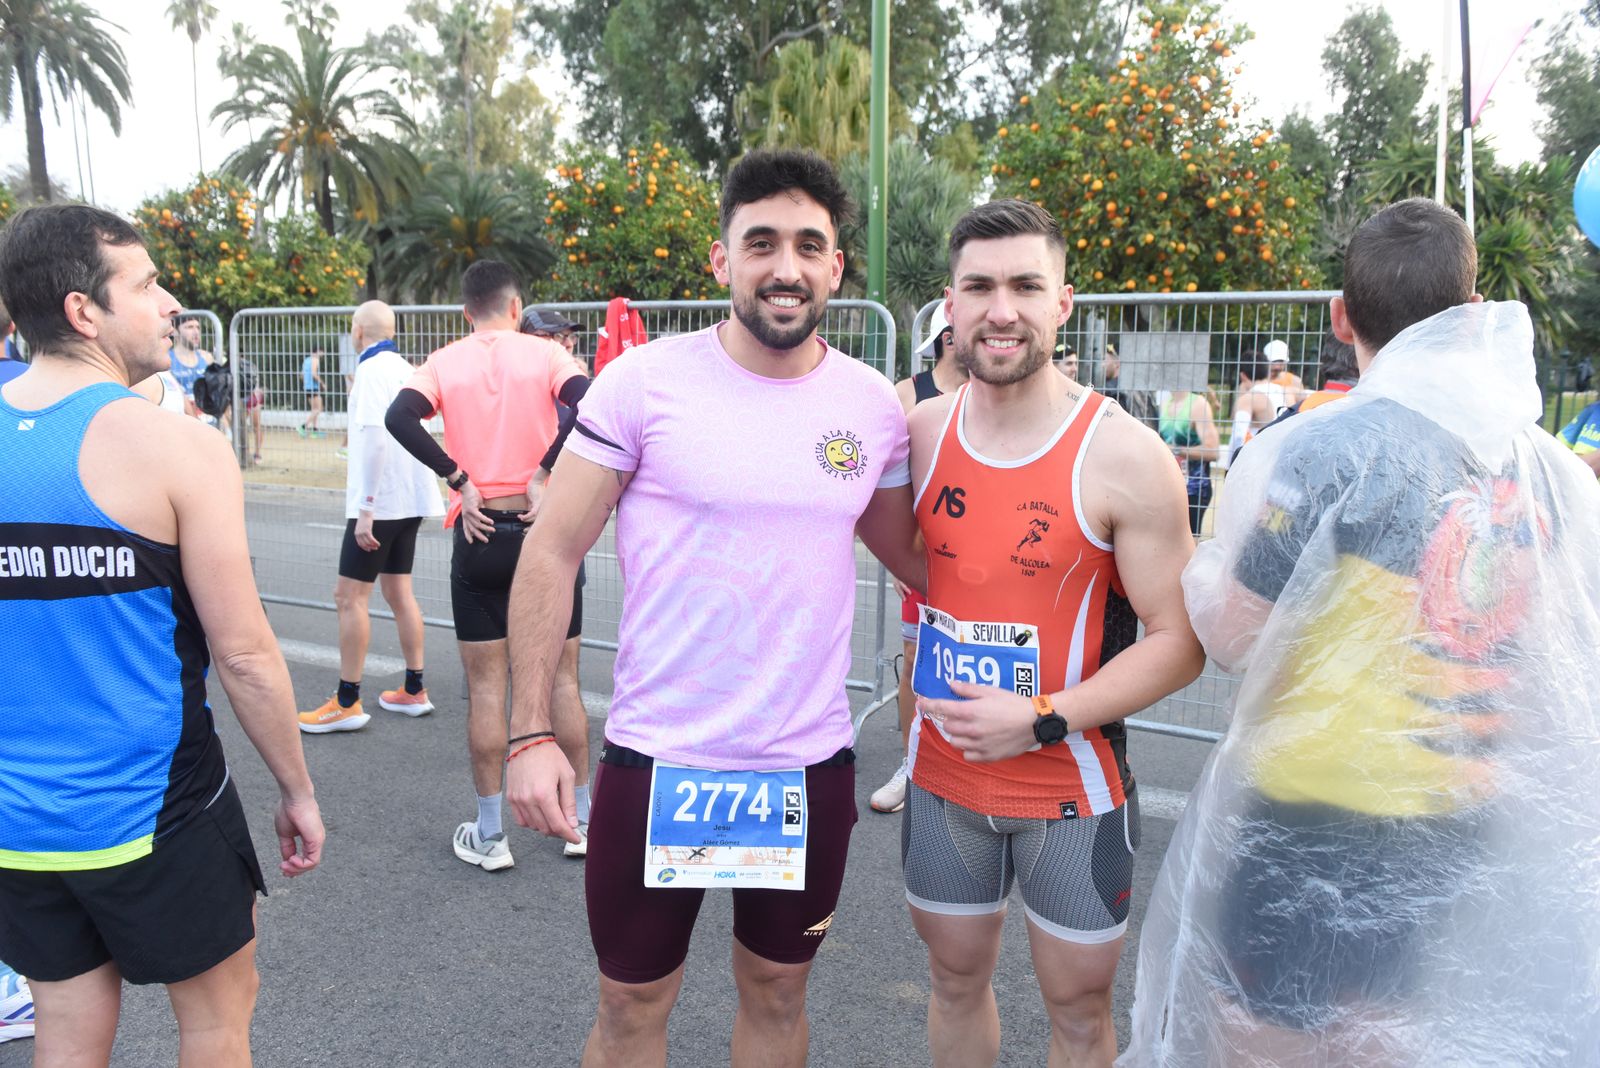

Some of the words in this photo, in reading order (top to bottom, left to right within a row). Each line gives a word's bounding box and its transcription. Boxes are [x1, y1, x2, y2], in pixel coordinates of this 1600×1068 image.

[822, 434, 831, 442] A
[830, 429, 843, 438] LA
[815, 442, 840, 478] LENGUA
[853, 454, 868, 478] SACA
[841, 472, 854, 481] LA
[1029, 501, 1059, 517] BATALLA
[53, 546, 136, 578] DUCIA
[1010, 555, 1019, 564] DE
[1019, 557, 1051, 569] ALCOLEA
[973, 623, 1017, 643] SEVILLA
[932, 641, 1001, 688] 1959
[672, 780, 772, 823] 2774
[713, 871, 737, 879] HOKA
